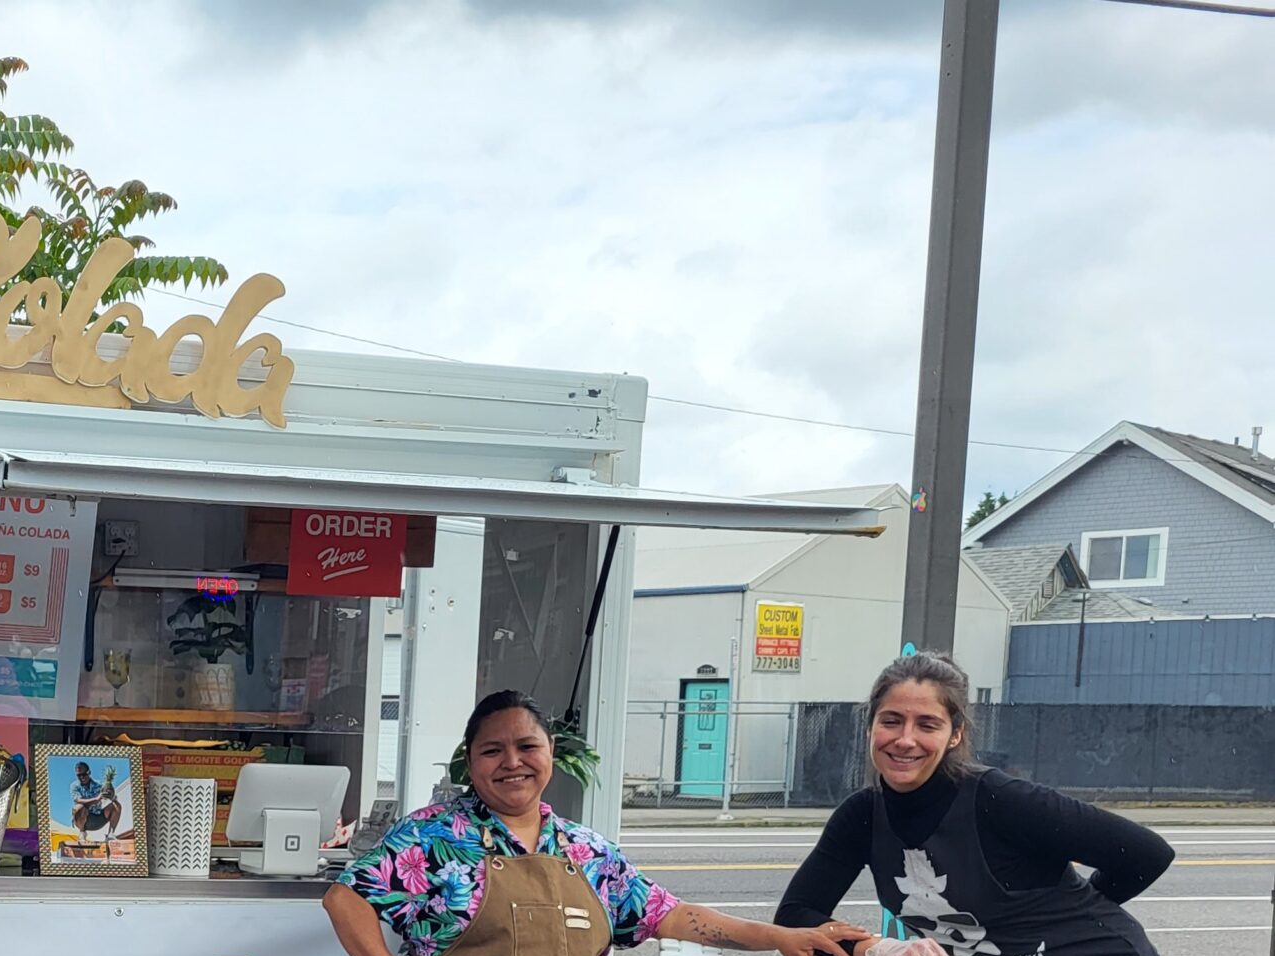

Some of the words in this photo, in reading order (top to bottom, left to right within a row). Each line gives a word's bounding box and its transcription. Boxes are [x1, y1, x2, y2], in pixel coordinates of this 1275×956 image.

[305, 513, 392, 538] ORDER
[19, 526, 70, 539] COLADA
[317, 548, 366, 569] Here
[20, 597, 37, 608] $5
[764, 609, 798, 622] CUSTOM
[165, 755, 182, 764] DEL
[185, 756, 221, 765] MONTE
[223, 757, 251, 765] GOLD
